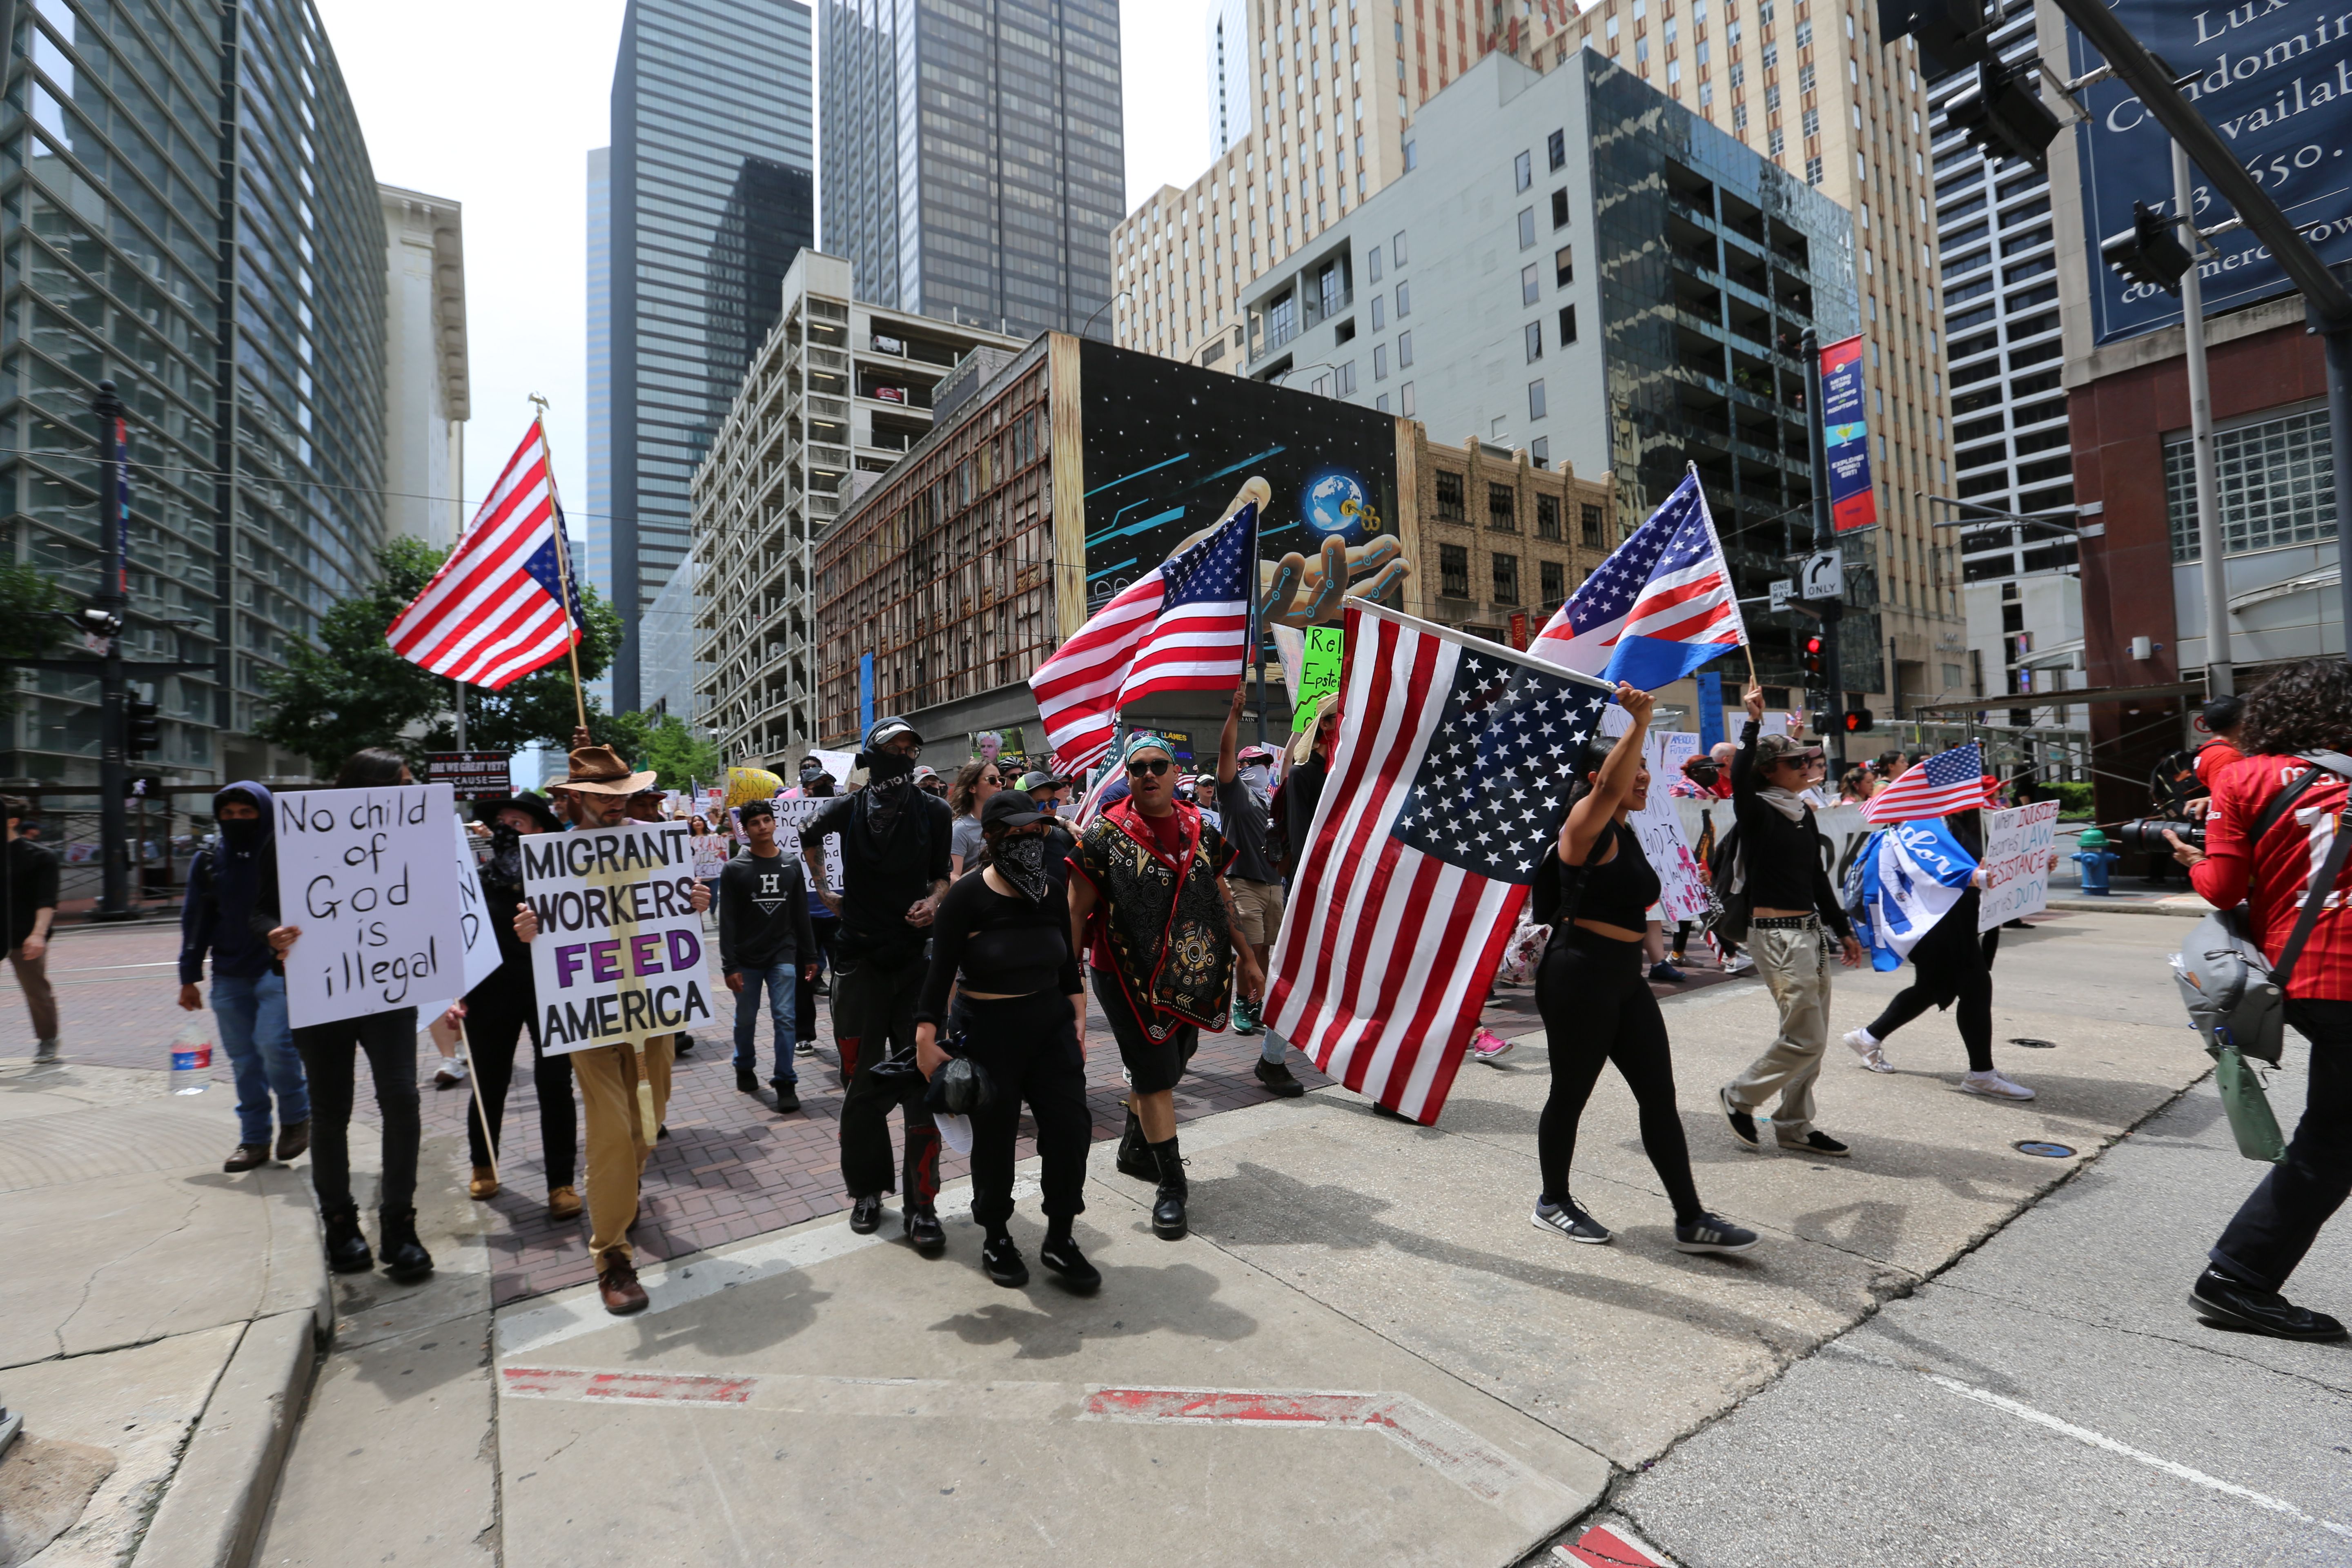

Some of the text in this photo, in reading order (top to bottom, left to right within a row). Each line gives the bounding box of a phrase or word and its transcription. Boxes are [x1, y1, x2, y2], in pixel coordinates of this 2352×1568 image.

[1773, 581, 1789, 591] ONE
[1773, 590, 1790, 599] WAY
[1808, 583, 1836, 595] ONLY
[1513, 618, 1524, 641] Holy
[1160, 731, 1187, 742] LLAMES
[429, 761, 508, 773] ARE WE GREAT YET?
[735, 779, 772, 792] KING
[281, 790, 426, 835] No child
[2016, 802, 2058, 828] INJUSTICE
[2022, 819, 2056, 853] LAW
[343, 833, 387, 874] of
[523, 829, 688, 880] MIGRANT
[760, 874, 780, 893] H
[1987, 849, 2046, 889] RESISTANCE
[306, 861, 408, 921] God
[525, 876, 697, 934] WORKERS
[2014, 879, 2045, 909] DUTY
[357, 918, 388, 947] is
[323, 935, 437, 1004] illegal
[555, 929, 701, 989] FEED
[542, 980, 710, 1047] AMERICA
